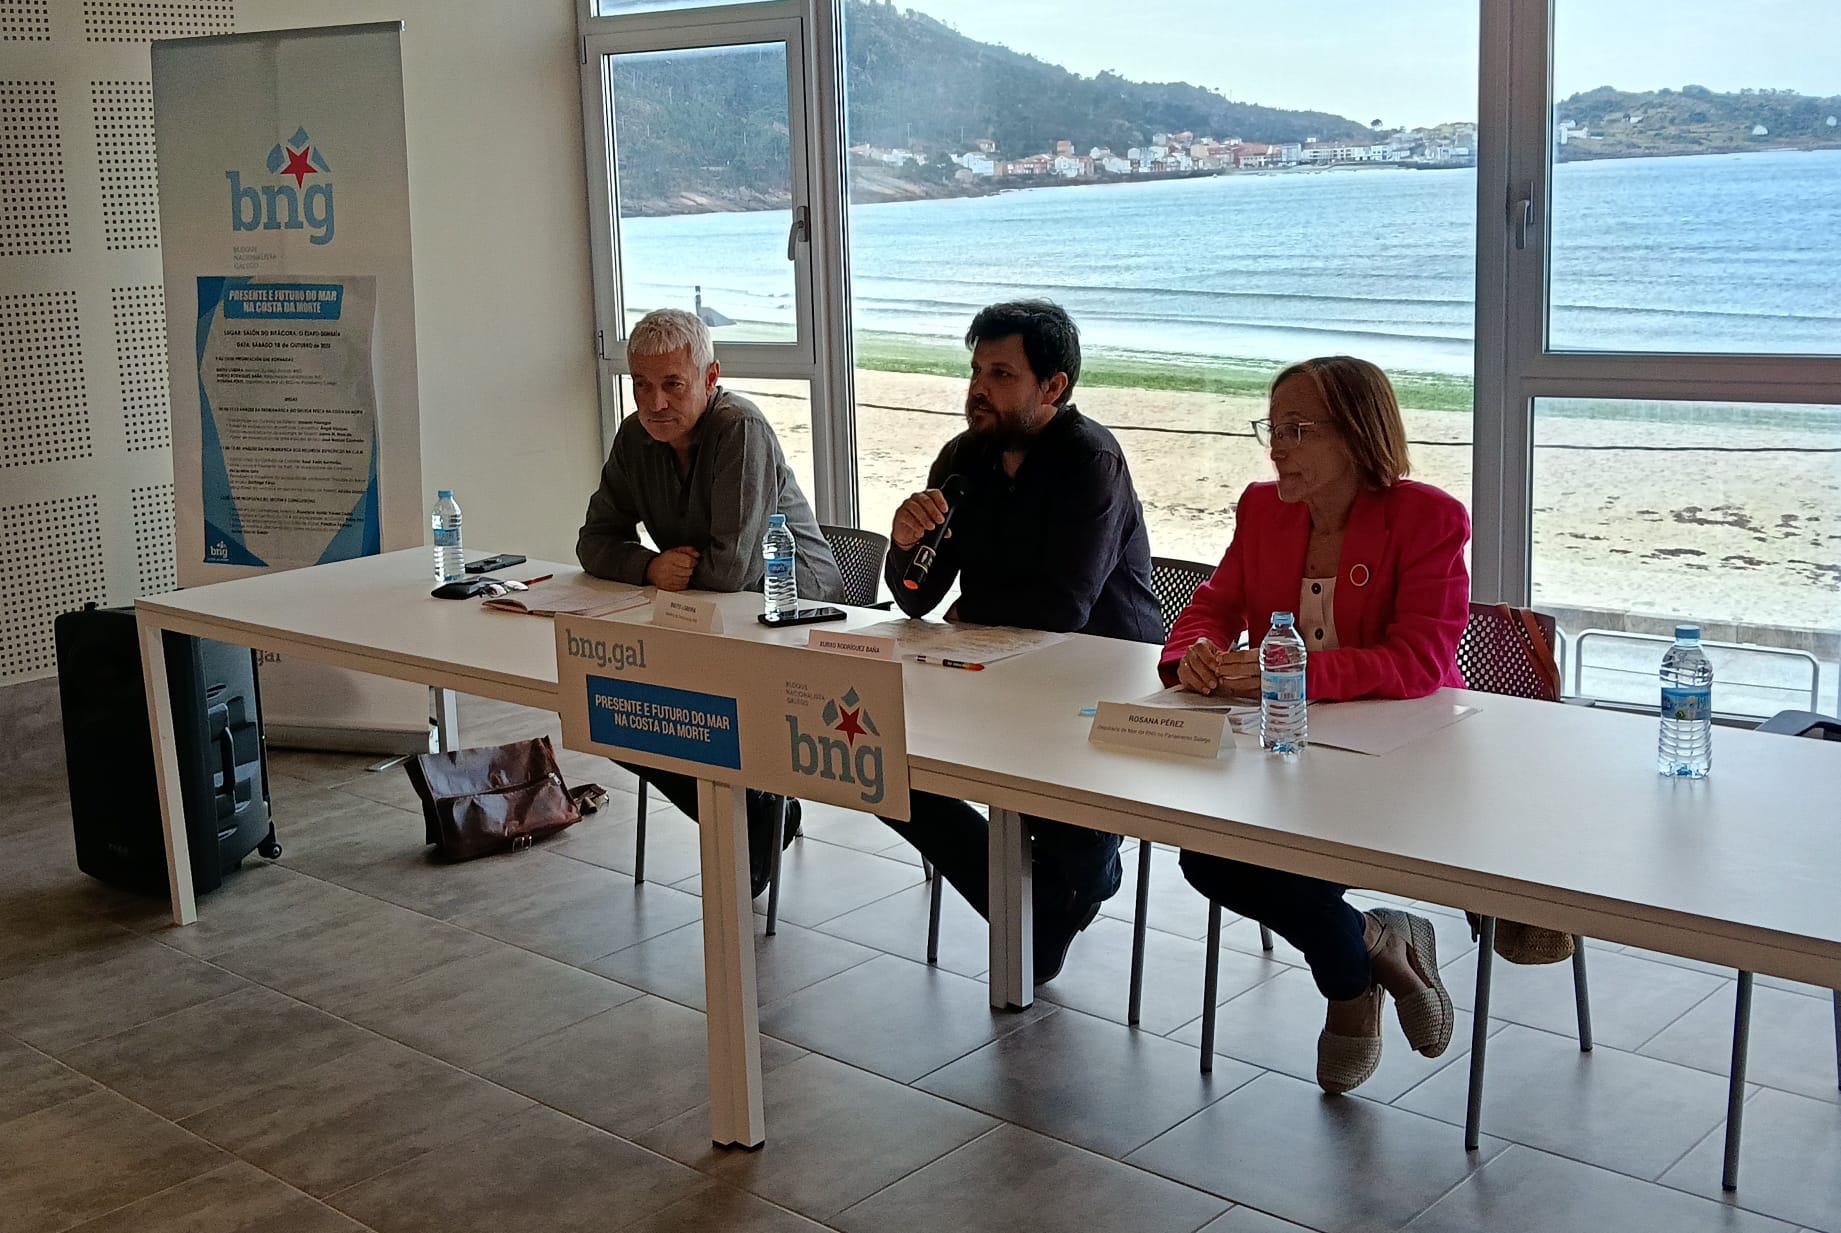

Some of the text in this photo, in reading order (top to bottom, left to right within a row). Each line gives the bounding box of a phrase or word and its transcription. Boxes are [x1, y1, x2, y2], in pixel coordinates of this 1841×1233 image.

[225, 170, 335, 245] bng
[229, 290, 337, 301] PRESENTE E FUTURO DO MAR
[243, 302, 321, 313] NA COSTA DA MORTE
[210, 545, 228, 559] bng
[565, 628, 647, 671] bng.gal
[594, 694, 731, 731] PRESENTE E FUTURO DO MAR
[614, 712, 711, 743] NA COSTA DA MORTE
[1128, 714, 1185, 728] ROSANA PÉREZ
[785, 714, 885, 804] bng
